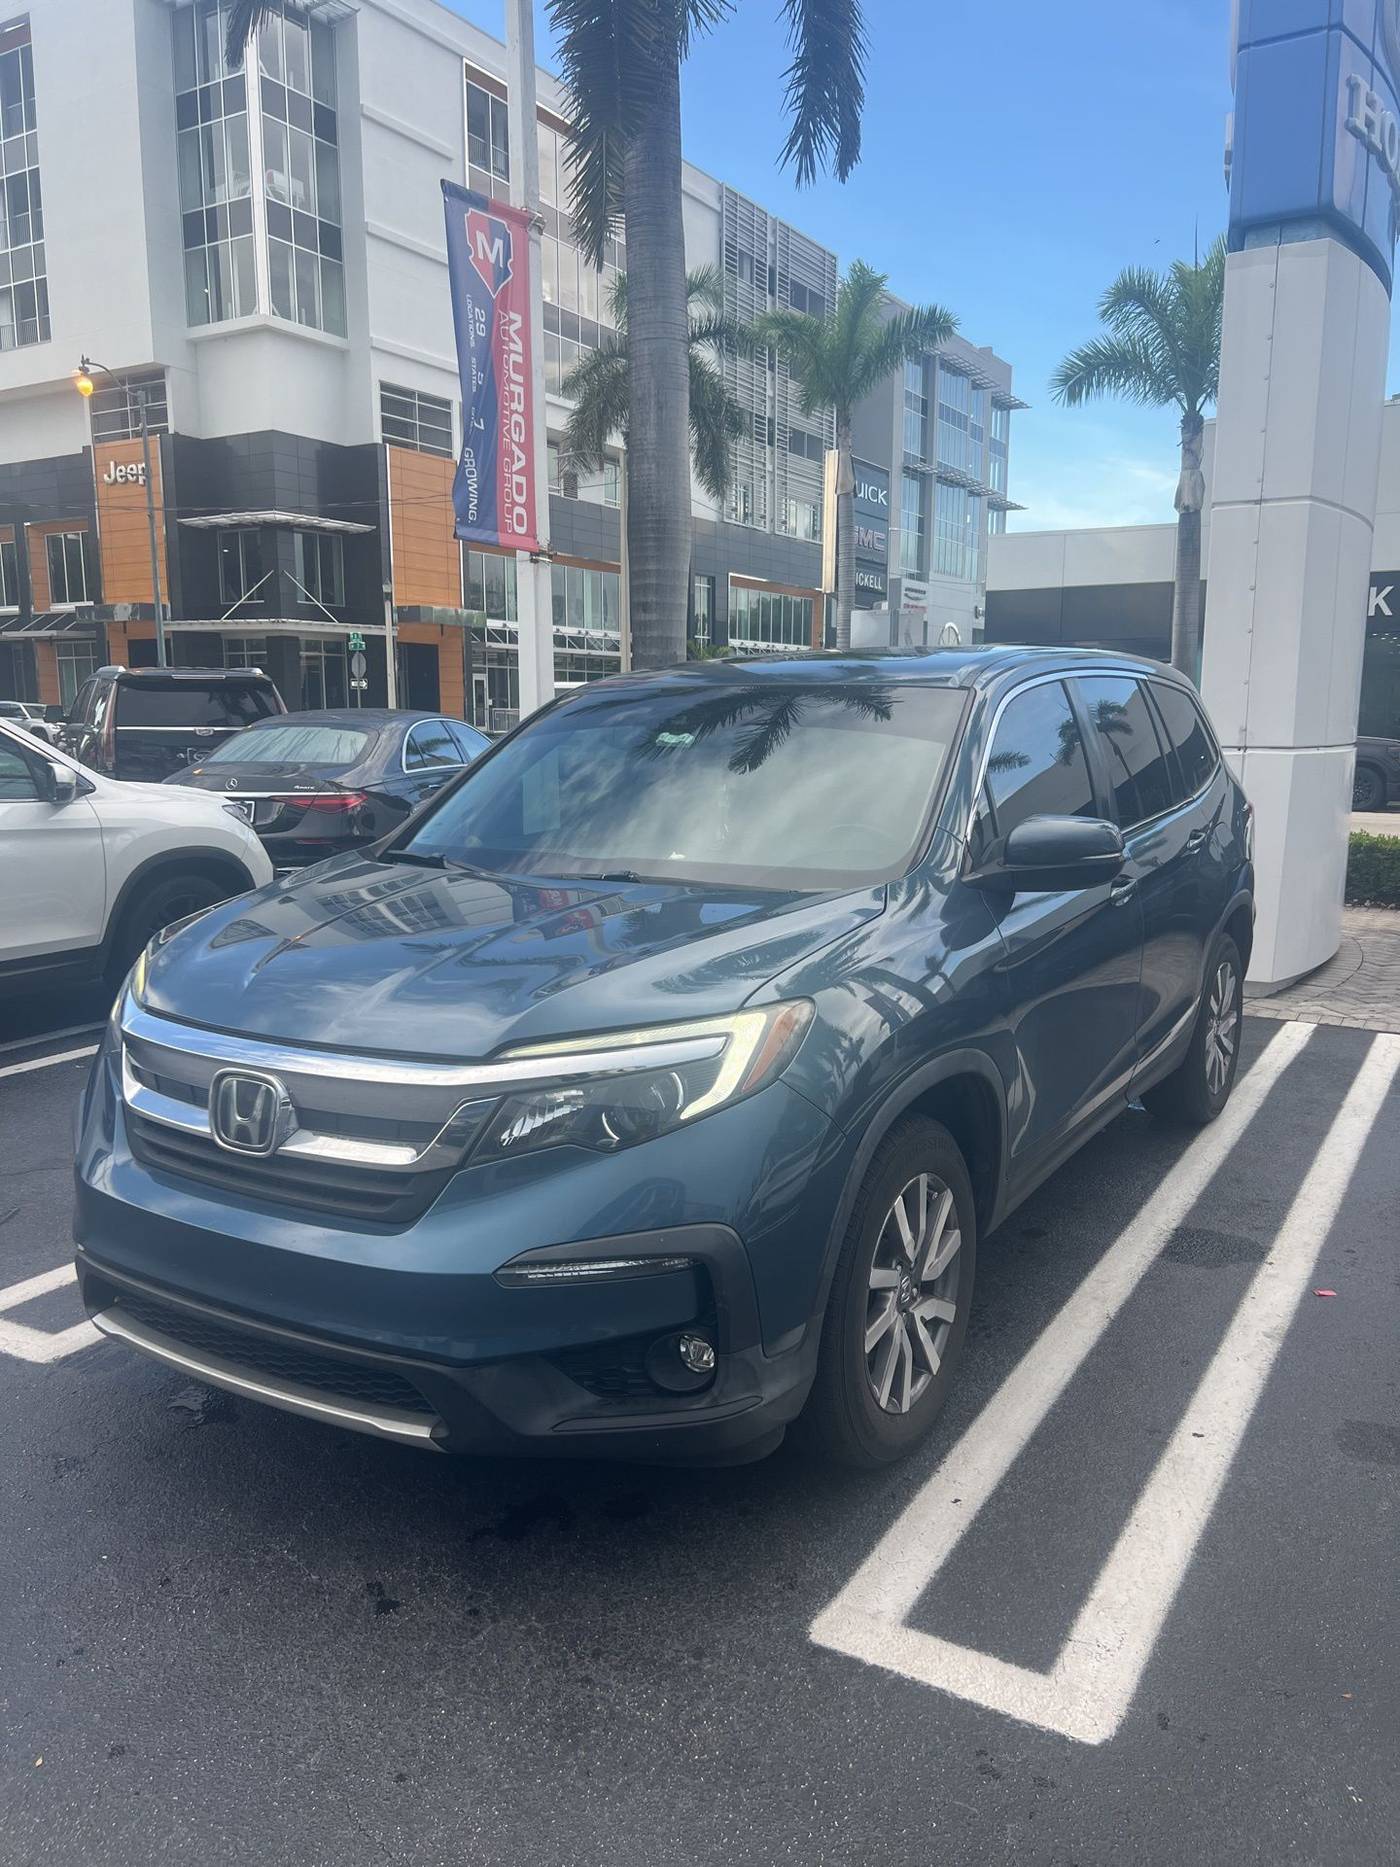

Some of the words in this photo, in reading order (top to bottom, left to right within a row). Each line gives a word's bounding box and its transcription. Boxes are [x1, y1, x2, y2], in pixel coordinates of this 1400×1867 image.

[1344, 73, 1400, 190] HO
[476, 230, 504, 268] M
[474, 307, 486, 337] 29
[498, 310, 512, 450] AUTOMOTIVE
[509, 311, 528, 535] MURGADO
[463, 447, 480, 524] GROWING.
[502, 457, 512, 533] GROUP
[1367, 586, 1394, 616] K
